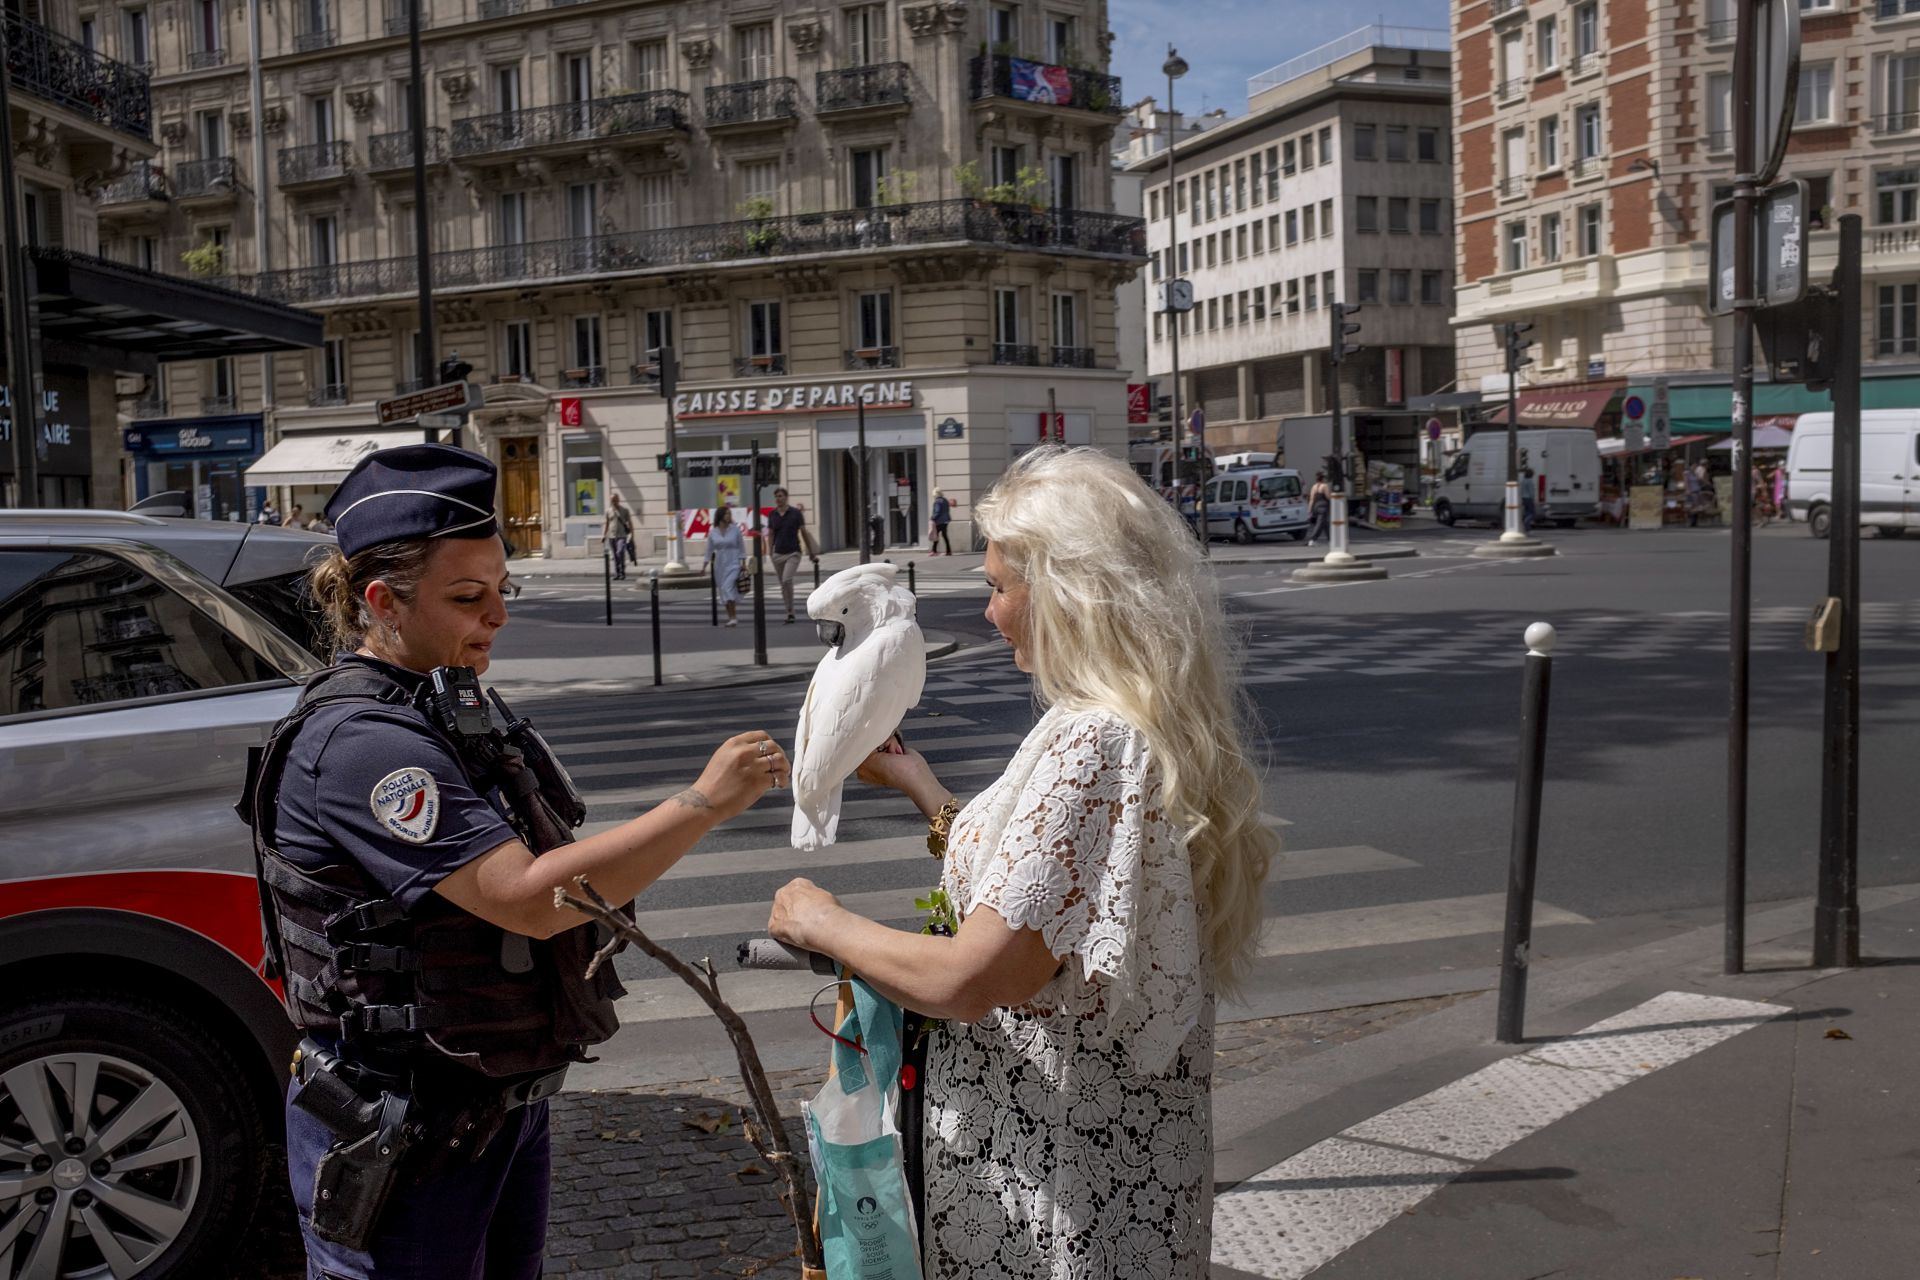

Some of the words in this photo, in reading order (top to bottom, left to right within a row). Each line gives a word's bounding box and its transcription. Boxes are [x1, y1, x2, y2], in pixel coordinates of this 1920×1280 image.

[674, 389, 757, 413] CAISSE
[767, 381, 913, 408] D'EPARGNE
[1522, 400, 1588, 412] BASILICO
[458, 689, 476, 698] POLICE
[382, 773, 413, 793] POLICE
[377, 778, 427, 806] NATIONALE
[859, 1235, 886, 1247] PRODUIT
[860, 1242, 888, 1253] OFFICIEL
